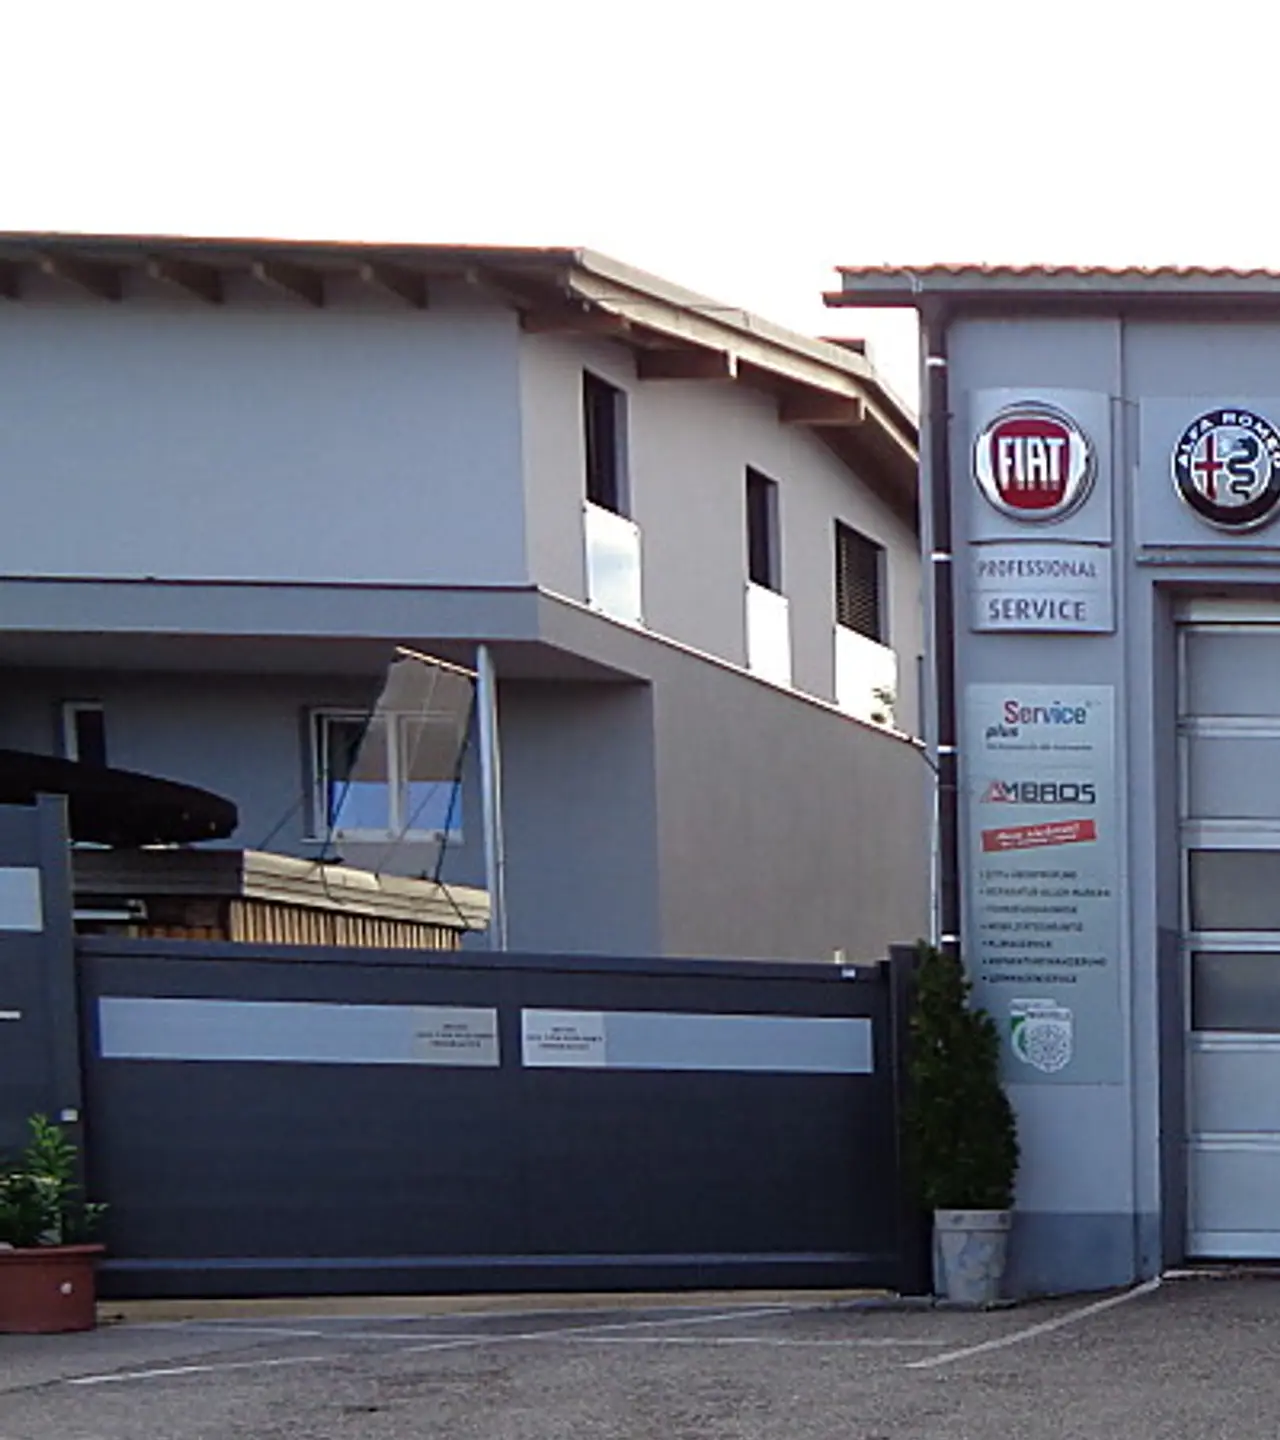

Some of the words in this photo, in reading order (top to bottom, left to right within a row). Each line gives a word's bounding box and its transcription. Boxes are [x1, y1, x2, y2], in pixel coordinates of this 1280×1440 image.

[1178, 417, 1214, 468] ALFA
[998, 437, 1066, 490] FIAT
[978, 558, 1097, 579] PROFESSIONAL
[988, 599, 1087, 622] SERVICE
[1004, 699, 1087, 725] Service
[986, 722, 1019, 740] plus
[980, 780, 1096, 804] AMBROS
